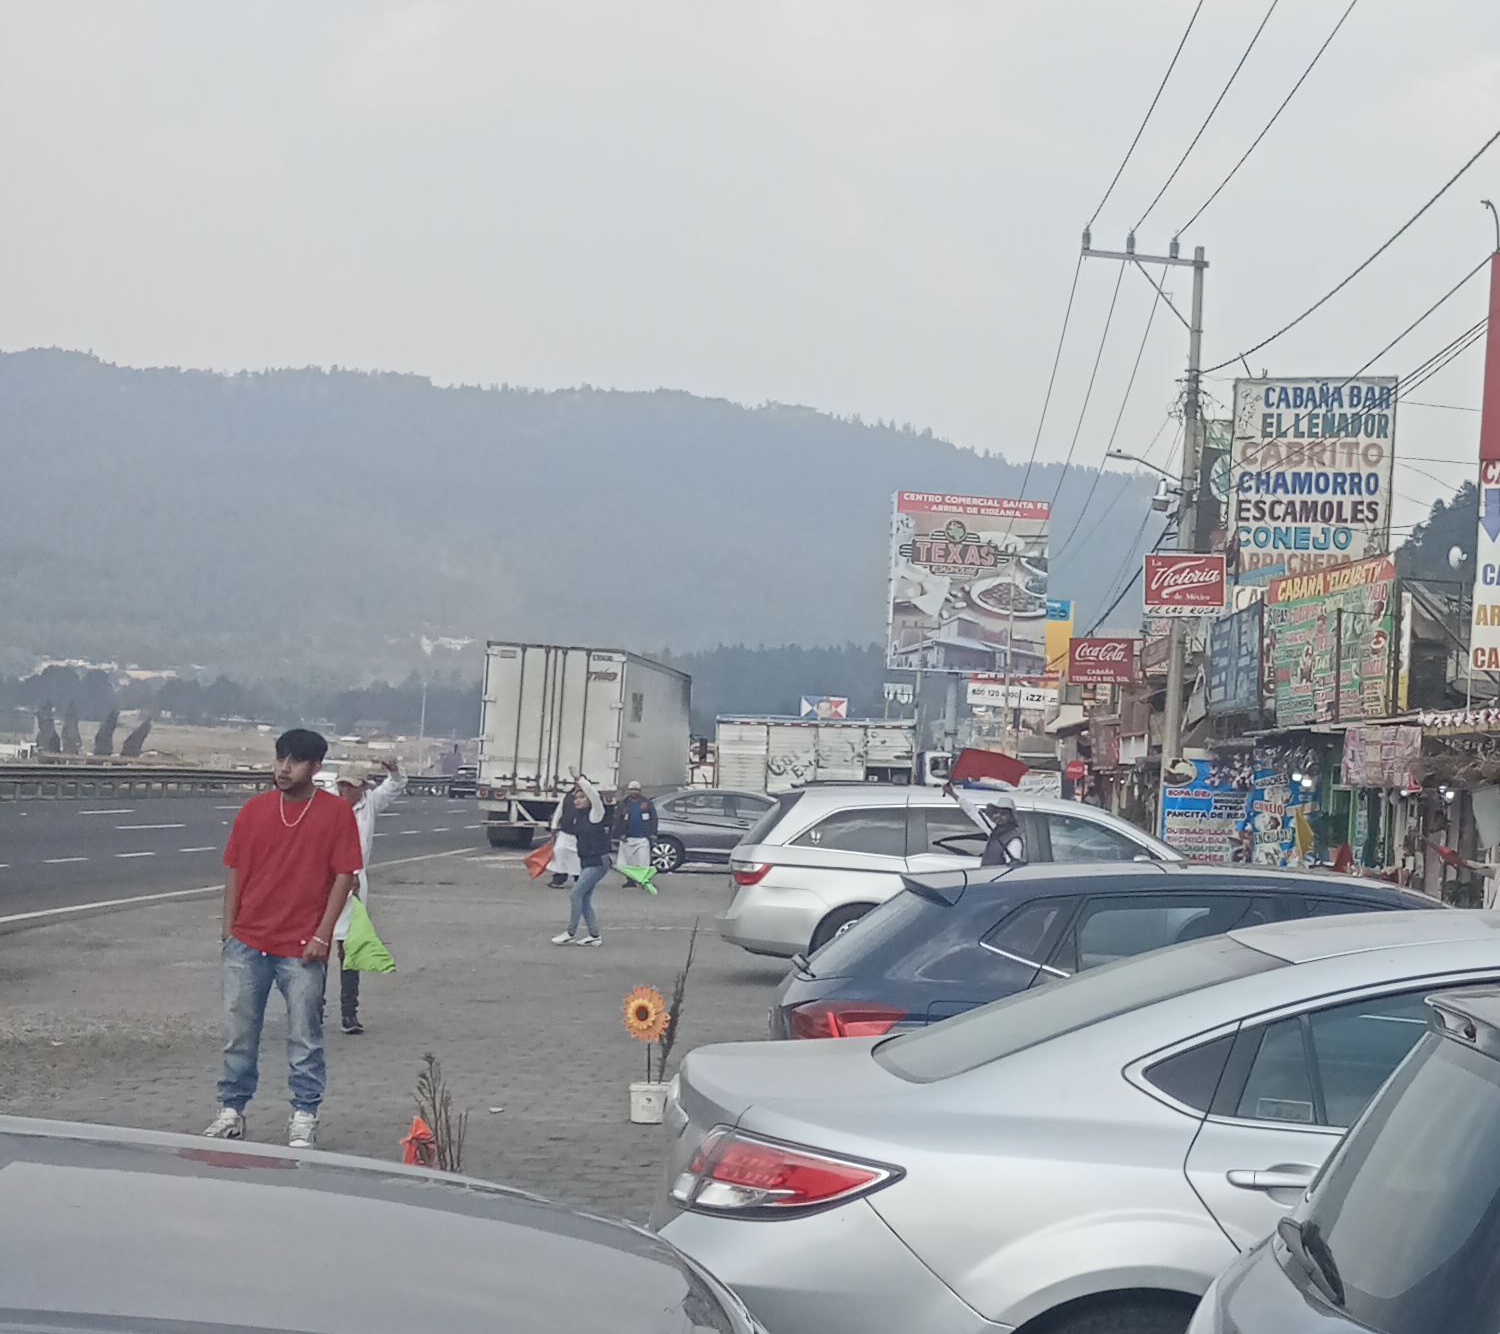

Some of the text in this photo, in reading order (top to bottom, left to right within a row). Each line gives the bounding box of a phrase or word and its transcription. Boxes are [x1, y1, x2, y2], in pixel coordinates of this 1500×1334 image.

[1264, 382, 1391, 410] CABAÑA BAR
[1262, 409, 1389, 439] EL LEÑADOR
[1240, 441, 1384, 467] CABRITO
[1239, 471, 1379, 495] CHAMORRO
[904, 493, 1048, 510] CENTRO COMERCIAL SANTA FE
[1237, 500, 1379, 524] ESCAMOLES
[1237, 527, 1352, 551] CONEJO
[916, 542, 995, 566] TEXAS
[1151, 558, 1220, 590] Victoria
